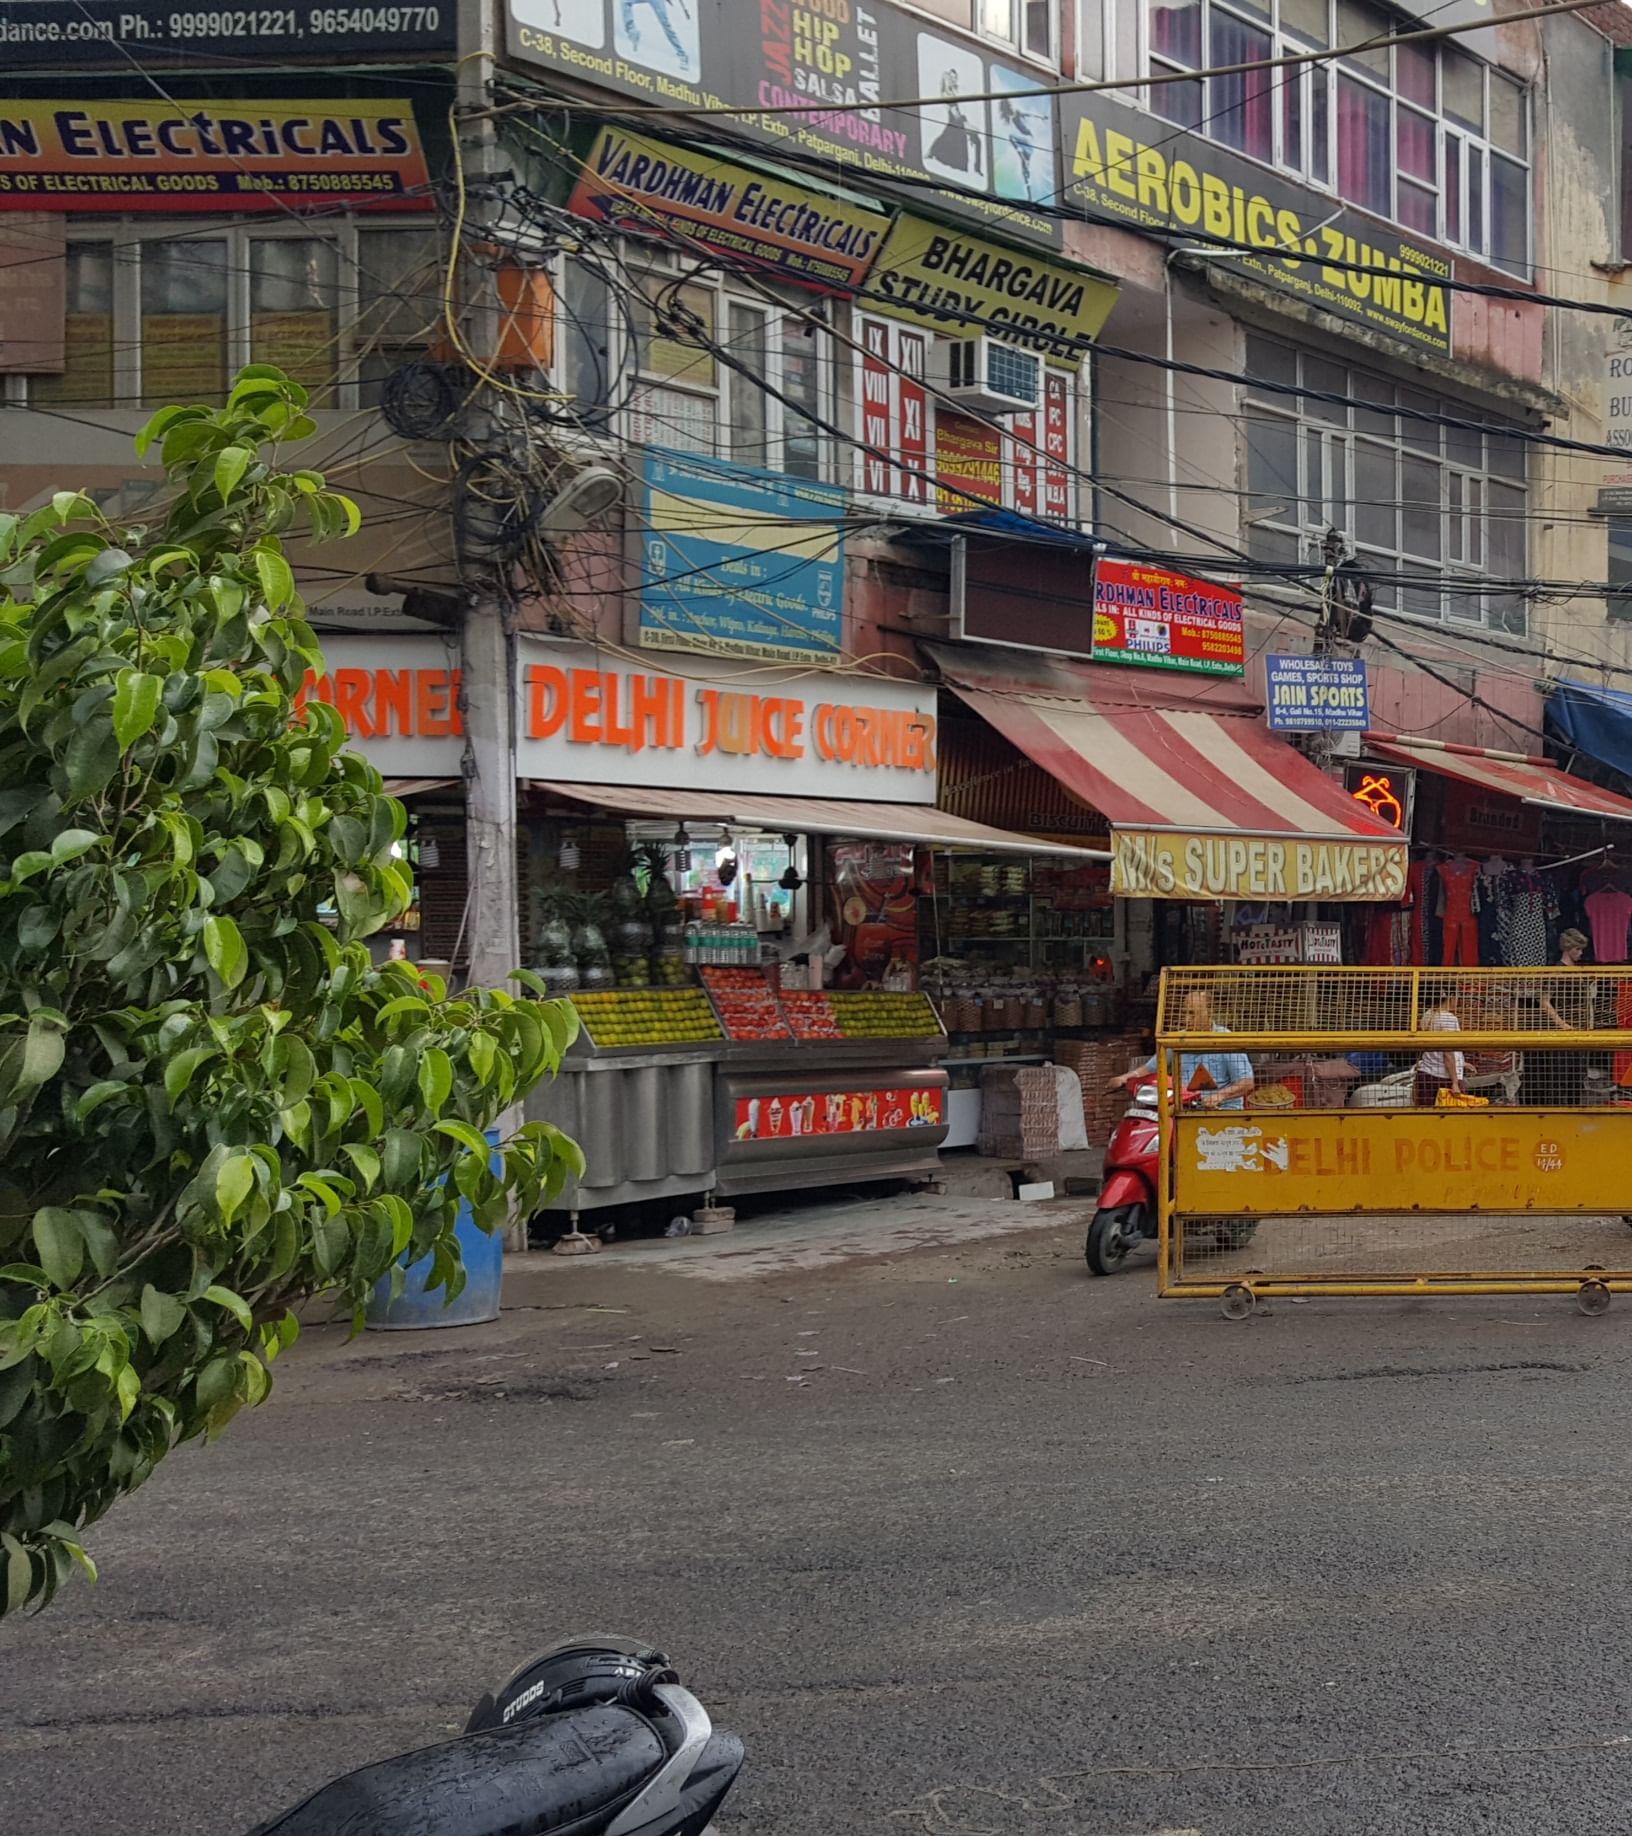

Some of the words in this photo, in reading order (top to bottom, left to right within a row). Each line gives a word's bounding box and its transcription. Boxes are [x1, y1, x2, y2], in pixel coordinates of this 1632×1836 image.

[120, 13, 163, 40] Ph.:
[169, 10, 304, 40] 9999021221,
[310, 7, 438, 34] 9654049770
[793, 9, 840, 46] HIP
[794, 37, 852, 79] HOP
[856, 6, 881, 123] BALLET
[520, 29, 557, 59] C-38,
[560, 42, 612, 75] Second
[615, 63, 654, 92] Floor,
[656, 76, 700, 106] Madhu
[797, 128, 864, 168] Patparganj,
[794, 67, 858, 105] SALSA
[758, 80, 908, 158] CONTEMPORARY
[17, 175, 38, 190] OF
[44, 175, 154, 191] ELECTRICAL
[157, 174, 219, 191] GOODS
[238, 174, 285, 190] Mob.:
[288, 174, 394, 191] 8750885545
[597, 133, 735, 215] VARDHMAN
[1073, 183, 1099, 206] C-38,
[1101, 193, 1138, 219] Second
[1072, 116, 1301, 269] AEROBICS
[1321, 226, 1448, 334] ZUMBA
[921, 236, 1085, 318] BHARGAVA
[1268, 264, 1313, 295] Patparganj,
[1400, 244, 1449, 278] 9999021221
[874, 271, 985, 328] STUDY
[985, 306, 1097, 364] CIRCLE
[868, 327, 883, 357] IX
[901, 335, 923, 383] XII
[864, 370, 887, 405] VIII
[1049, 380, 1061, 401] CA
[867, 415, 886, 448] VII
[904, 397, 921, 441] XI
[869, 460, 884, 492] VI
[907, 459, 920, 500] X
[1174, 613, 1217, 629] ELECTRICAL
[1217, 620, 1242, 632] GOODS
[1125, 638, 1169, 653] PHILIPS
[1271, 672, 1305, 683] GAMES,
[1306, 673, 1340, 684] SPORTS
[1340, 674, 1363, 685] SHOP
[1332, 661, 1353, 672] TOYS
[288, 667, 464, 741] ORNE
[525, 663, 685, 753] DELHI
[1273, 685, 1307, 706] JAIN
[1311, 685, 1365, 708] SPORTS
[696, 689, 805, 758] JUICE
[815, 703, 937, 773] CORNER
[1030, 811, 1097, 830] BISCUIT
[1184, 837, 1287, 894] SUPER
[1298, 842, 1406, 896] BAKERS
[1395, 1135, 1521, 1175] POLICE
[503, 1679, 545, 1725] STUDDS
